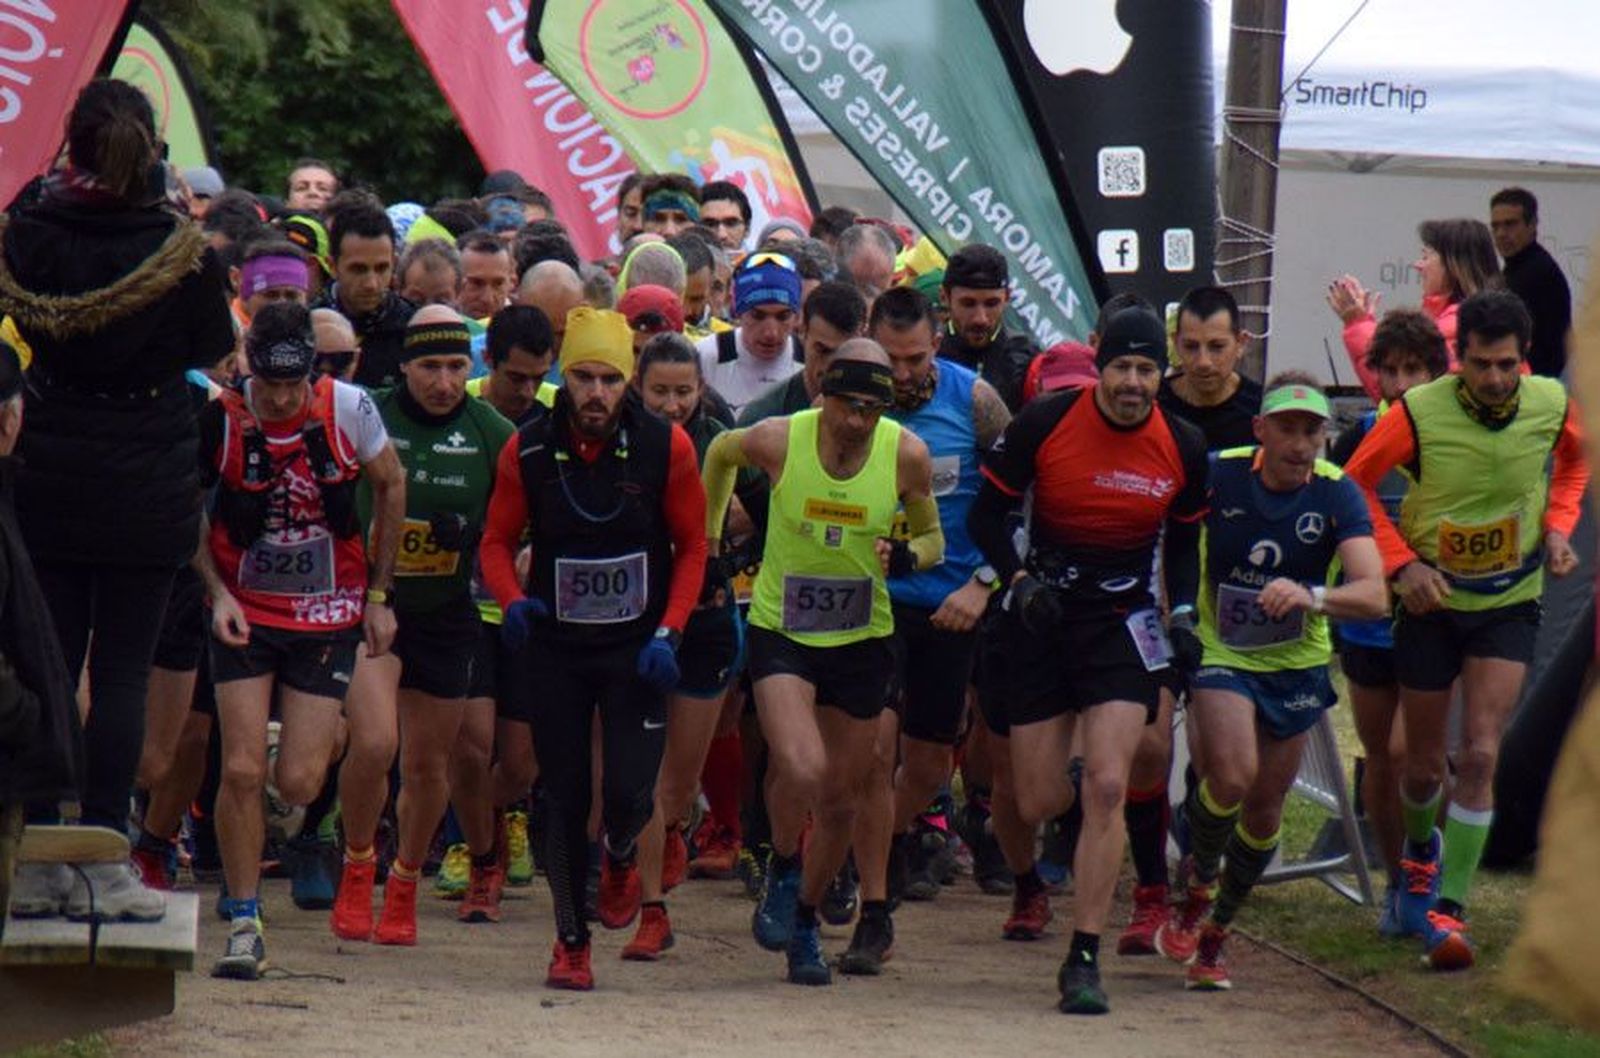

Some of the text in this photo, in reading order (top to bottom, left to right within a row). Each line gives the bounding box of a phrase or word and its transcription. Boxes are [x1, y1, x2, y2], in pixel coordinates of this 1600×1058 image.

[1295, 78, 1427, 113] SmartChip
[1449, 528, 1504, 555] 360
[254, 549, 315, 575] 528
[571, 568, 630, 597] 500
[798, 585, 857, 611] 537
